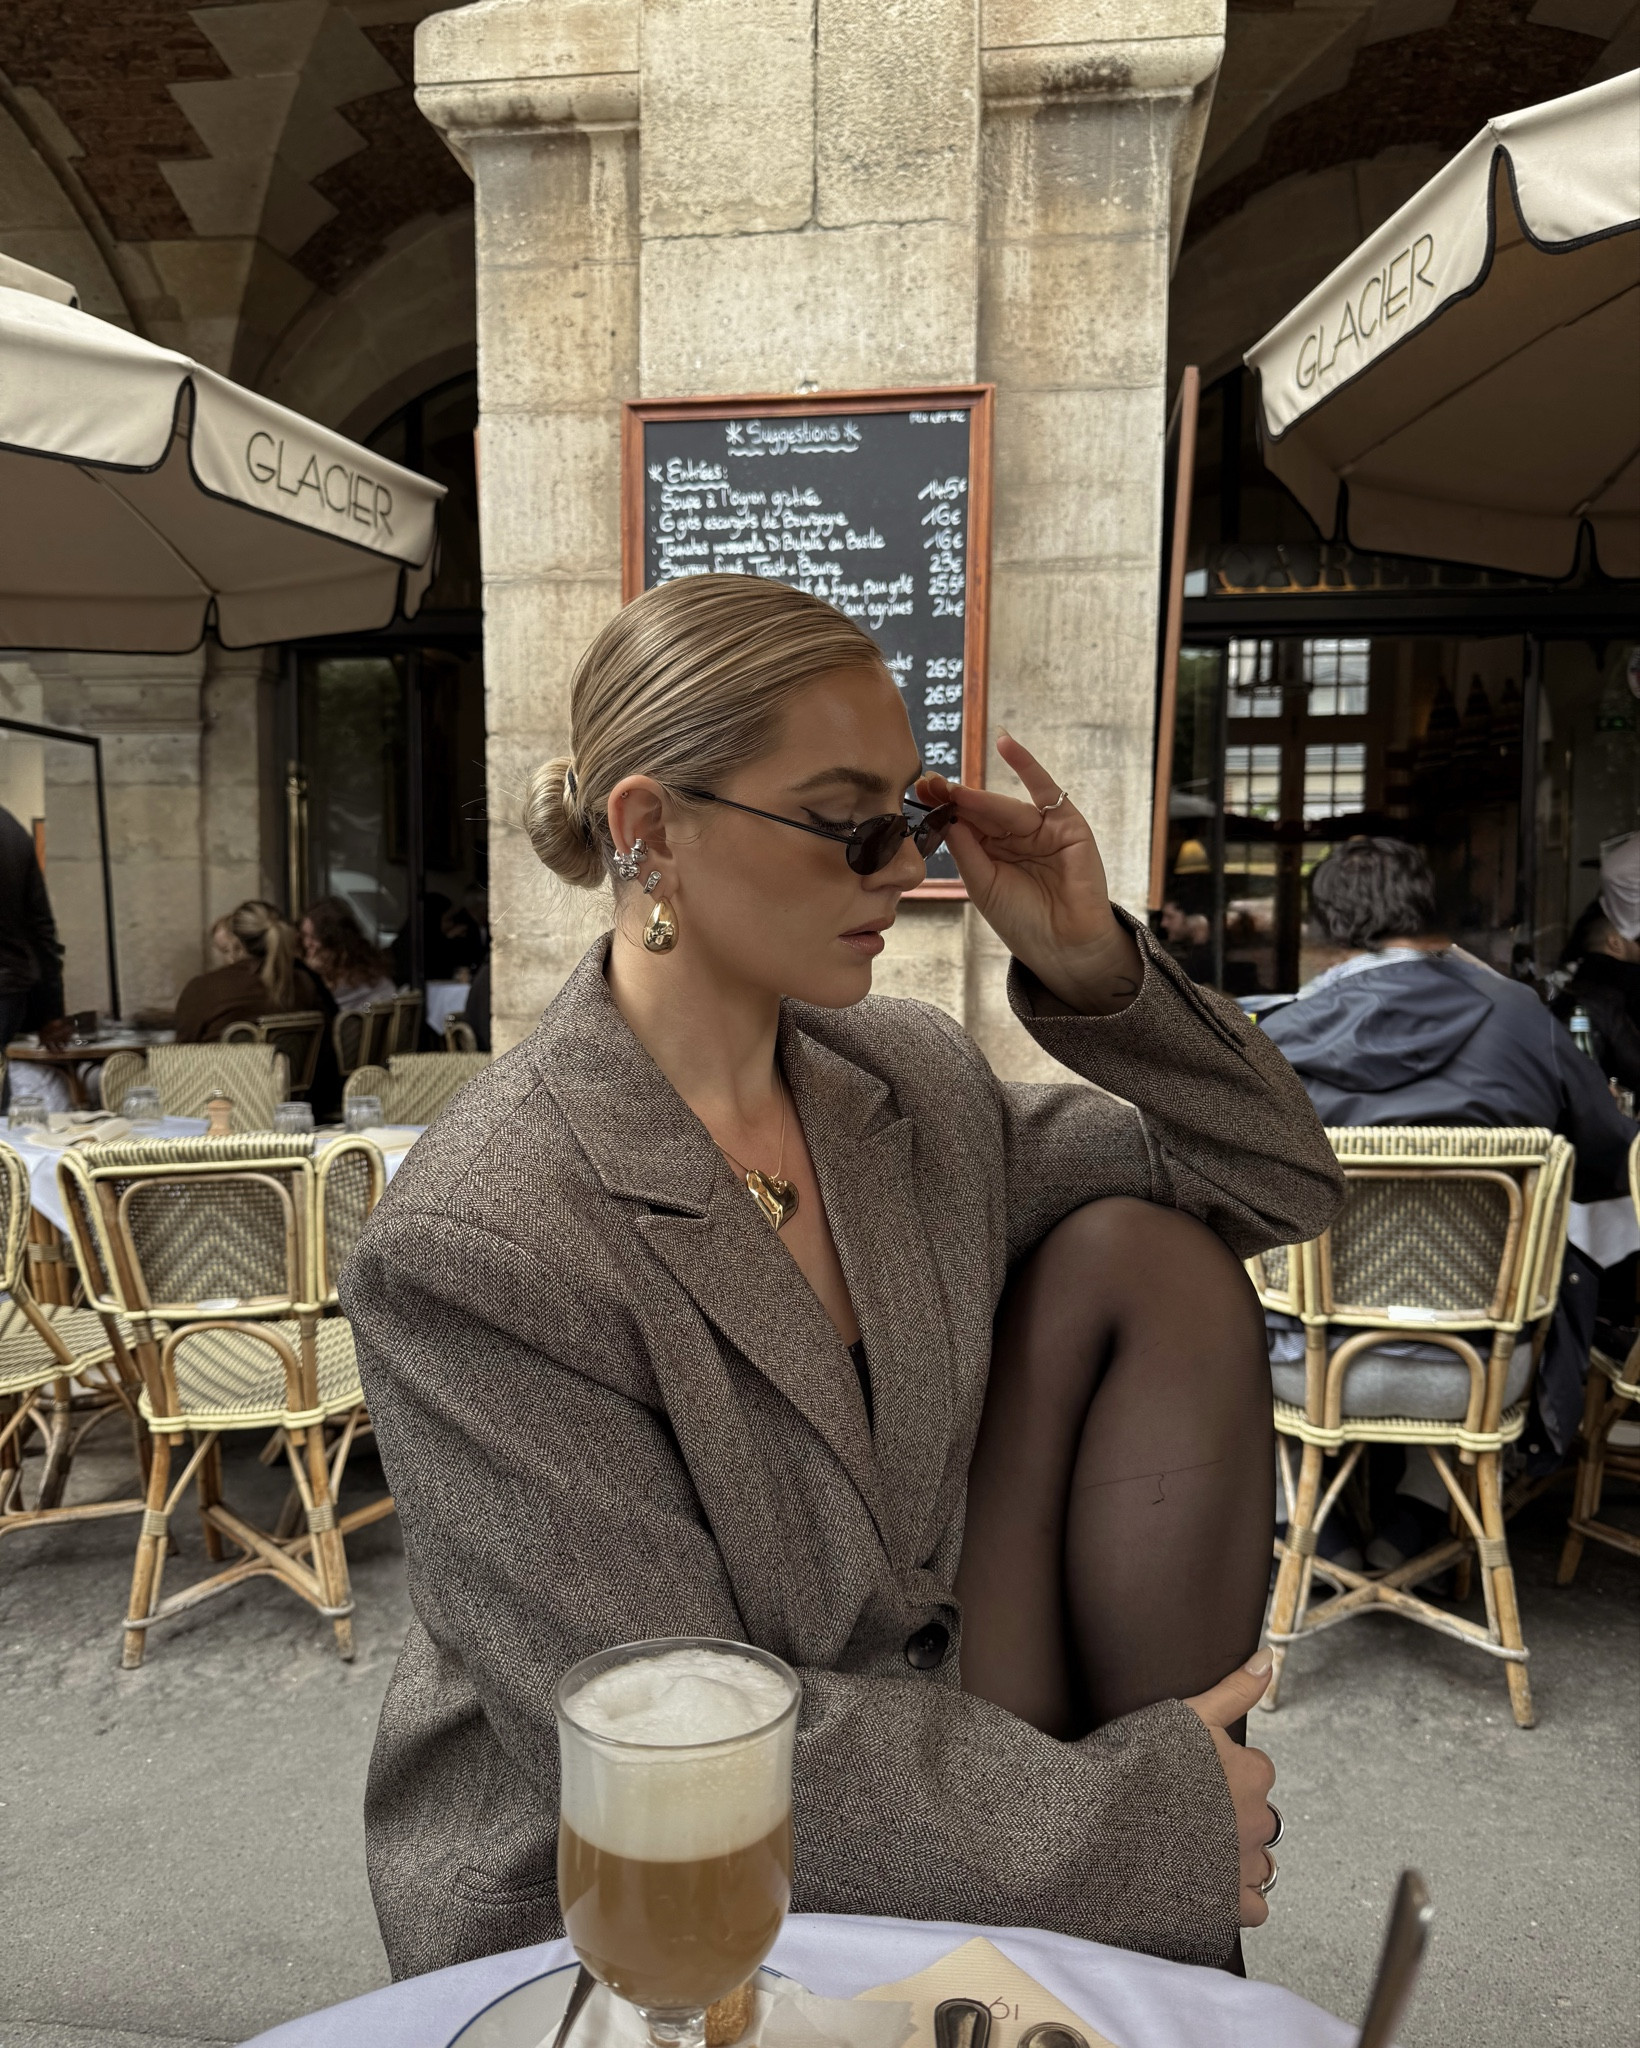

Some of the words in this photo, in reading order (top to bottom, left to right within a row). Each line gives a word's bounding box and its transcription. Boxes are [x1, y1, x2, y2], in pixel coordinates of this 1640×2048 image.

[1296, 234, 1435, 390] GLACIER
[746, 420, 840, 455] Suggestions
[246, 431, 395, 537] GLACIER
[660, 492, 702, 516] Soupe
[706, 492, 717, 509] à
[921, 502, 962, 526] 16€
[659, 513, 676, 532] 6
[762, 510, 781, 530] de
[923, 527, 964, 549] 16€
[748, 555, 787, 577] Toast
[929, 550, 964, 573] 23€
[867, 599, 914, 630] agrumes
[931, 597, 965, 618] 24€
[925, 741, 958, 765] 35€
